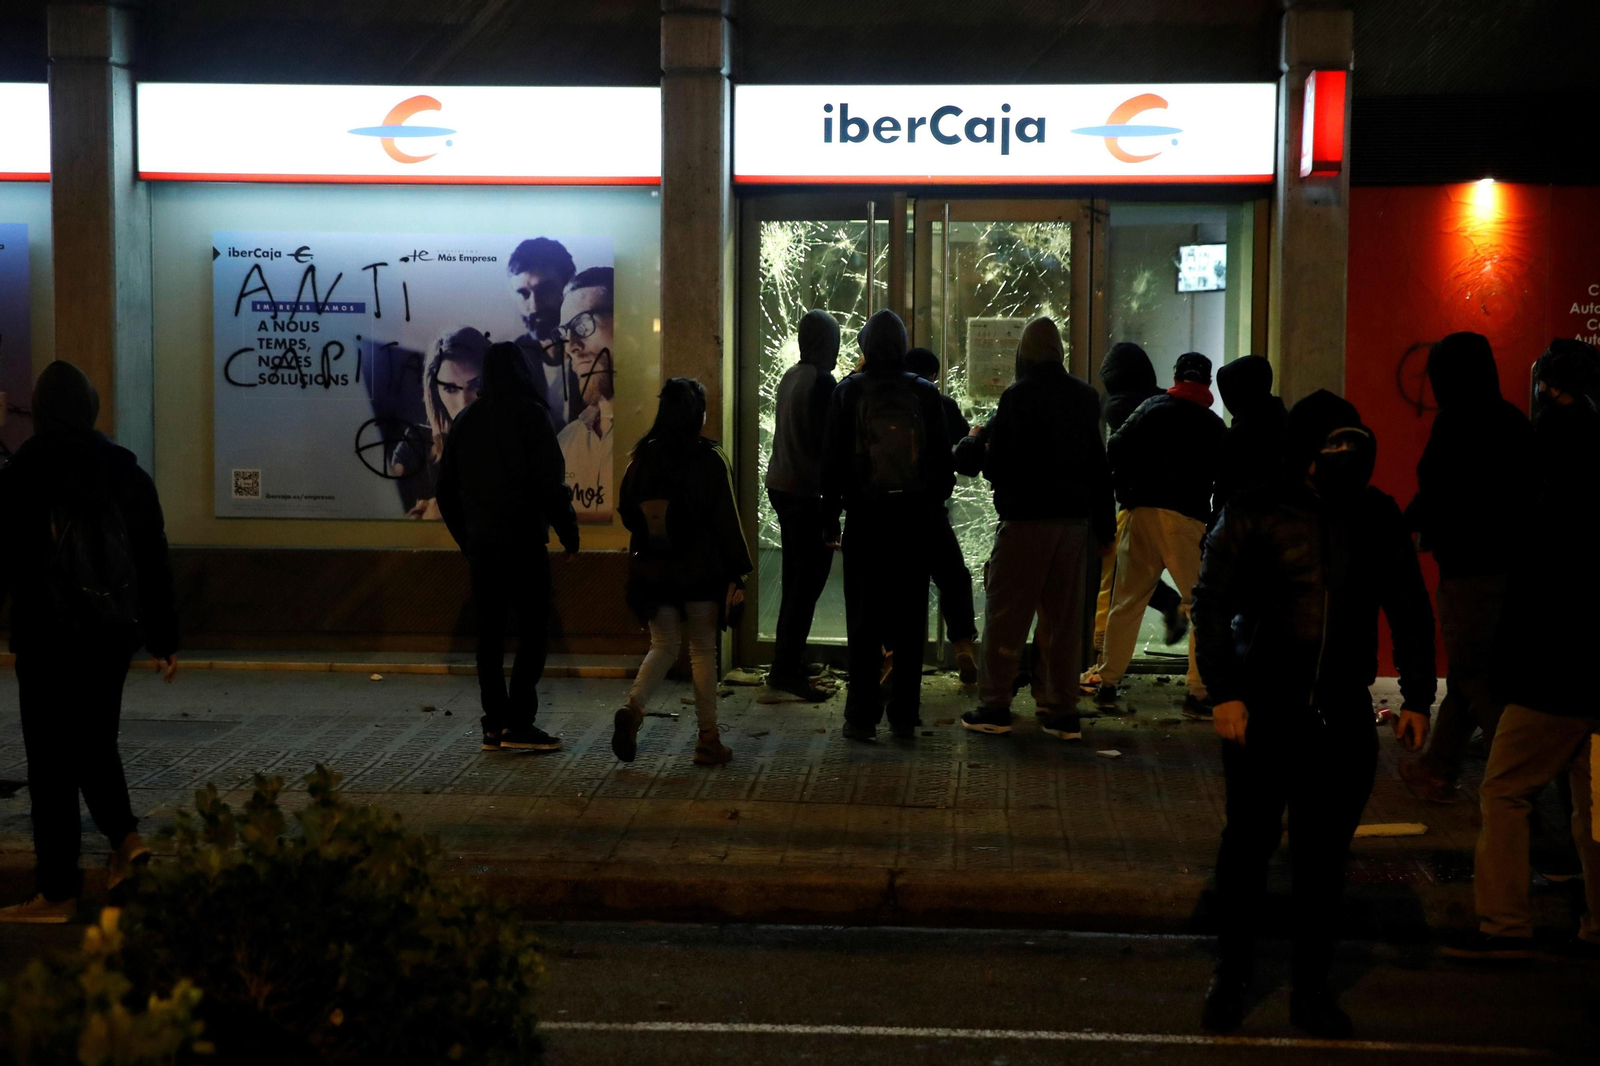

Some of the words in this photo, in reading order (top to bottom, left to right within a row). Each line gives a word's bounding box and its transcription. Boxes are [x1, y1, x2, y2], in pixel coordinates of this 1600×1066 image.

[824, 103, 1046, 155] iberCaja
[228, 247, 282, 261] iberCaja
[438, 253, 456, 262] Más
[459, 253, 497, 264] Empresa
[256, 303, 311, 311] EMREES
[318, 304, 355, 312] AMOS
[257, 320, 269, 332] A
[273, 320, 320, 333] NOUS
[257, 338, 311, 352] TEMPS,
[258, 355, 312, 368] NOVES
[258, 373, 349, 386] SOLUCIONS
